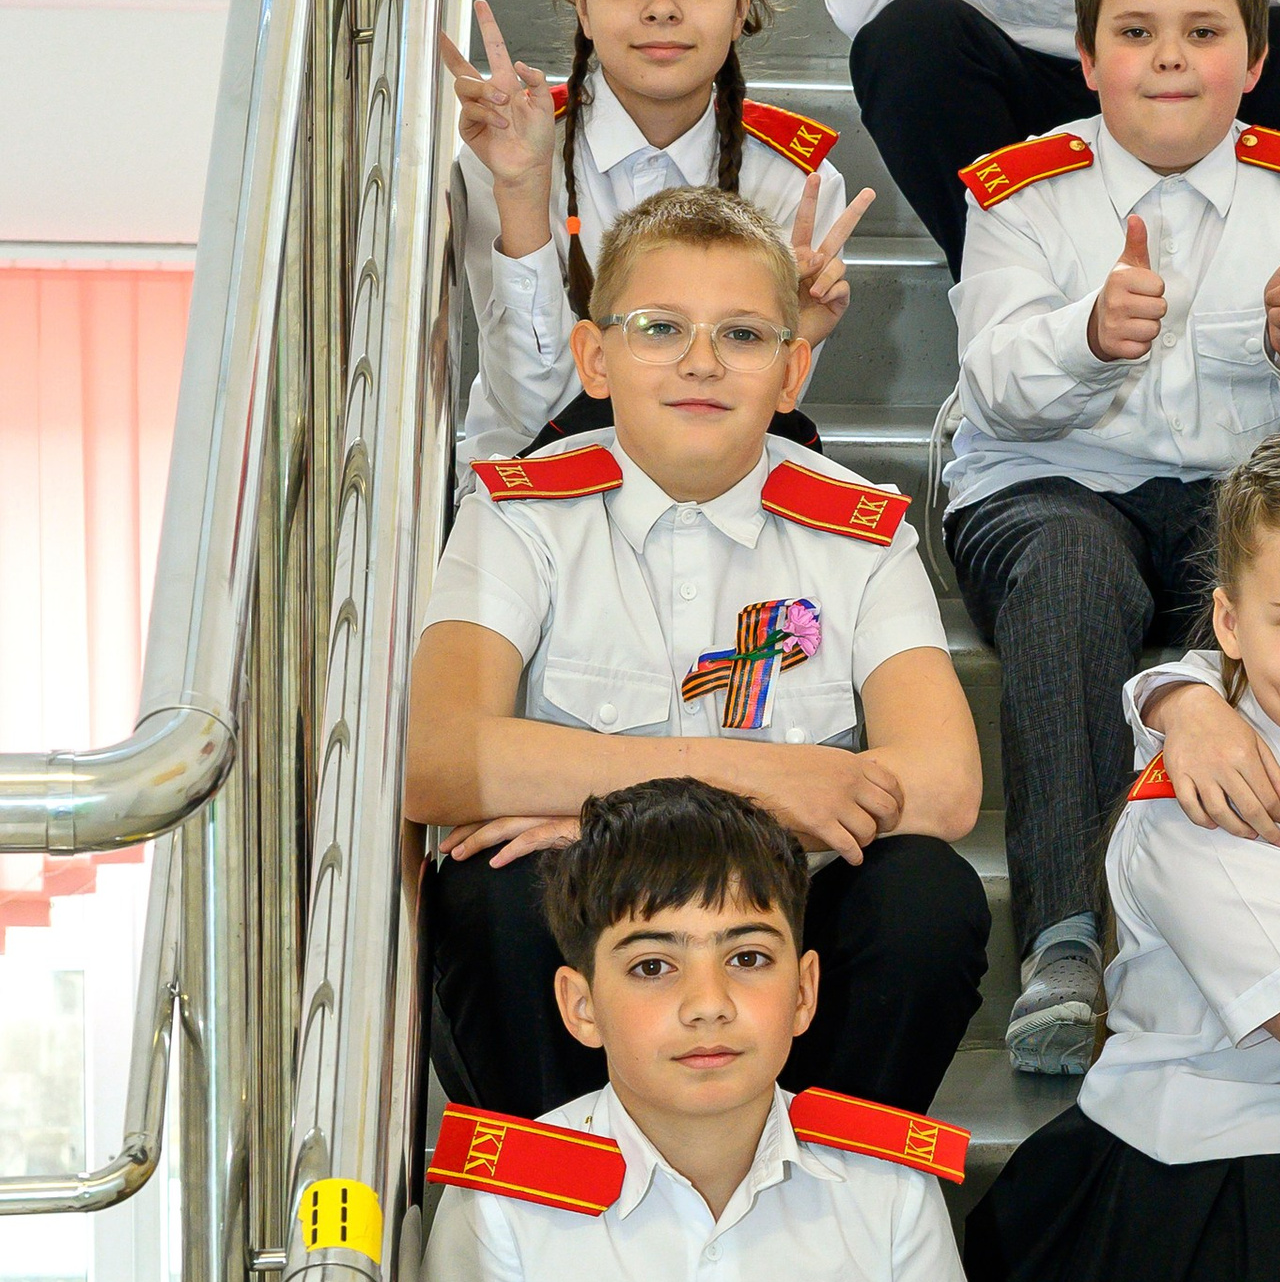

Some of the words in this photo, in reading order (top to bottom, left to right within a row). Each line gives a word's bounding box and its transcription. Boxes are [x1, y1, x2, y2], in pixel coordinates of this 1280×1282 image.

[789, 125, 822, 158] КК
[976, 162, 1010, 194] КК
[494, 465, 533, 489] КК
[848, 495, 888, 529] КК
[463, 1120, 508, 1177] КК
[903, 1120, 940, 1162] КК
